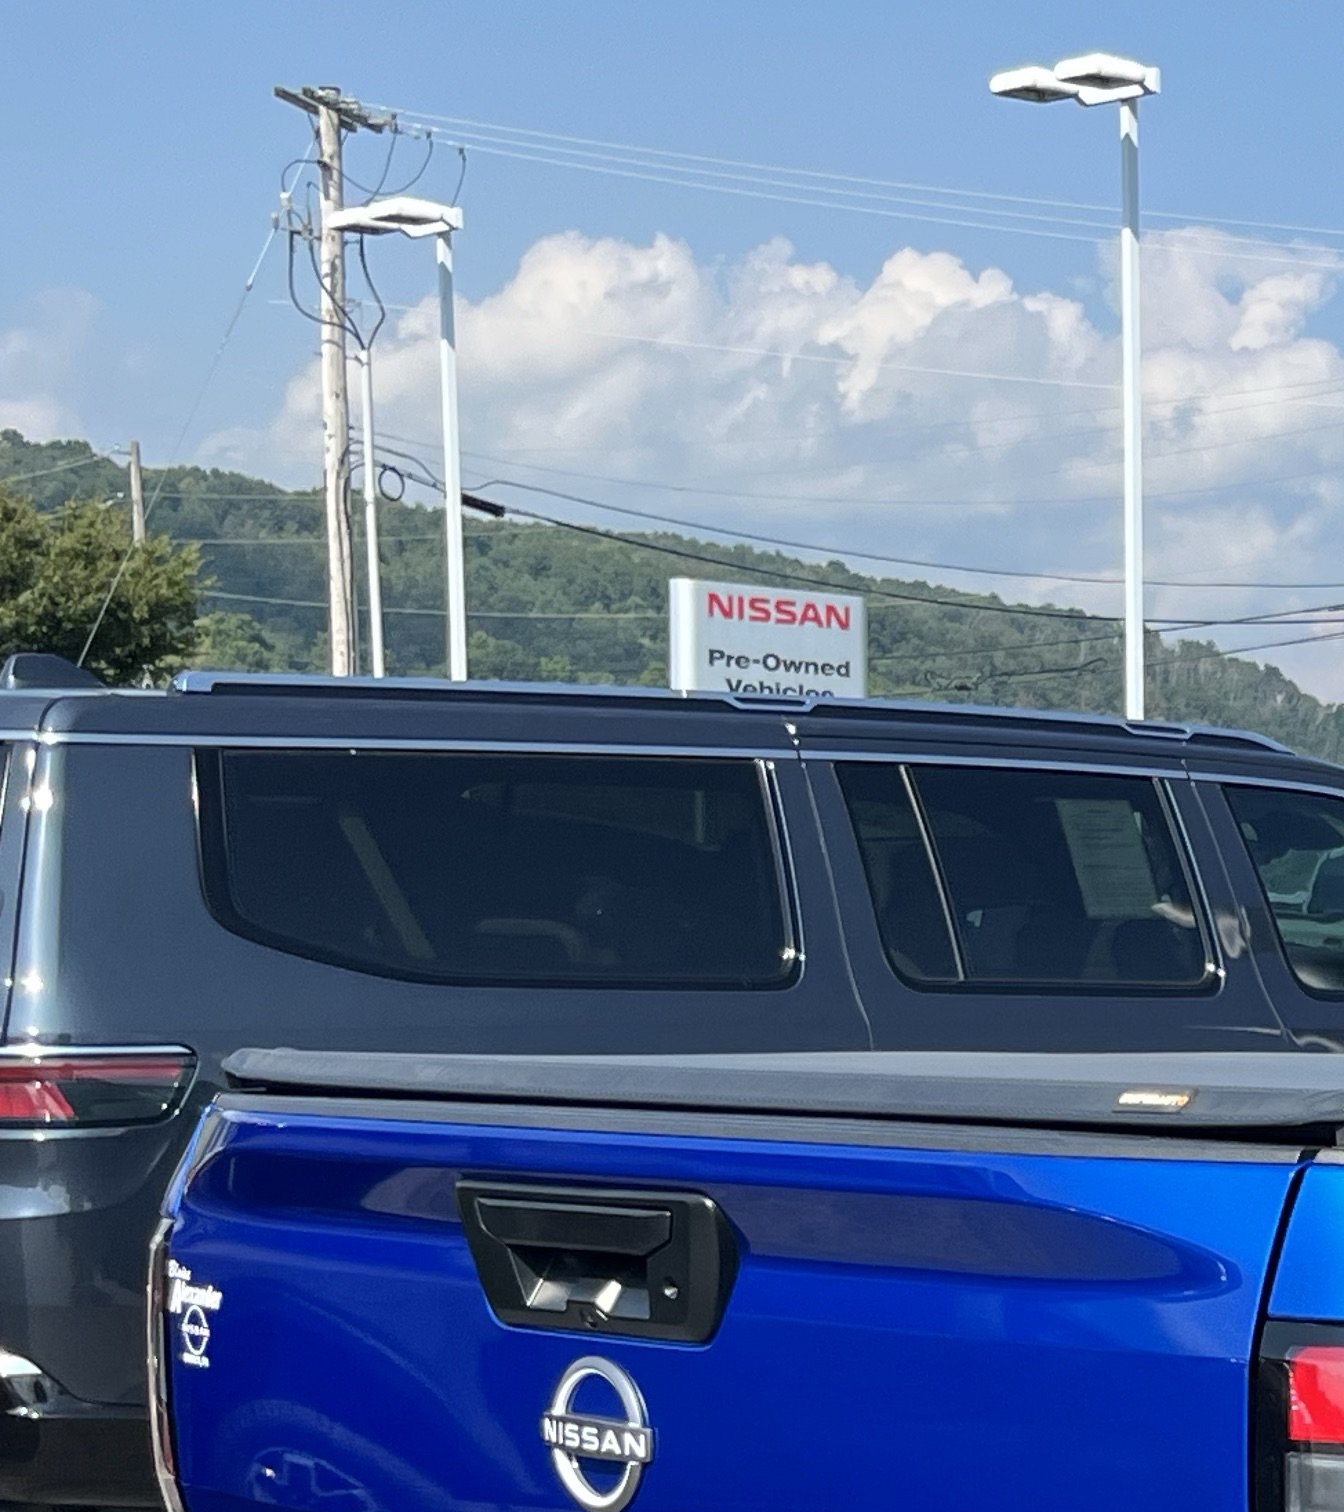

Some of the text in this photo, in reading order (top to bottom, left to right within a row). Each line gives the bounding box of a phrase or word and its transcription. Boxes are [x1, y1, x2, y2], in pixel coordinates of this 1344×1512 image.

[707, 591, 850, 631] NISSAN
[708, 649, 850, 677] Pre-Owned
[543, 1418, 647, 1458] NISSAN
